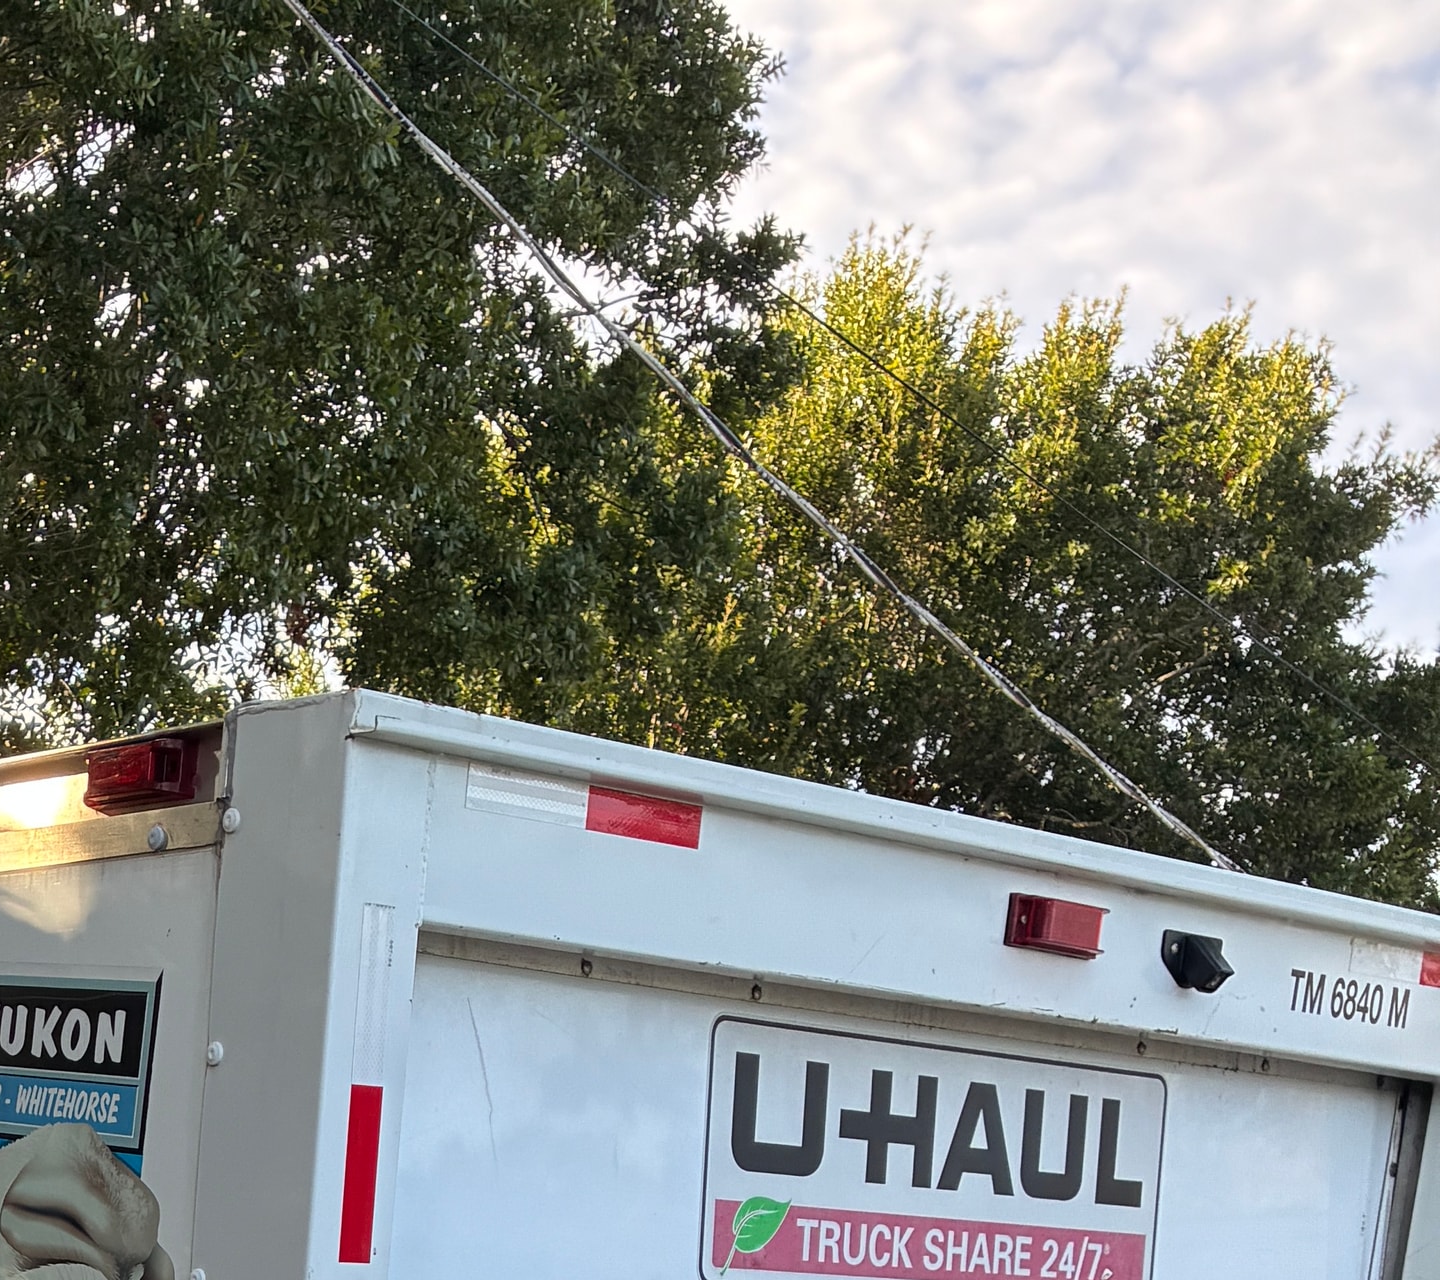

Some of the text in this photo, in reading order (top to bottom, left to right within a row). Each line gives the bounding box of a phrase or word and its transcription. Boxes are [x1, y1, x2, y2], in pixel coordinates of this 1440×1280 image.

[1290, 968, 1411, 1029] TM 6840 M
[15, 1084, 121, 1124] WHITEHORSE
[731, 1051, 1143, 1208] U-HAUL
[796, 1217, 913, 1270] TRUCK
[922, 1239, 1030, 1277] SHARE
